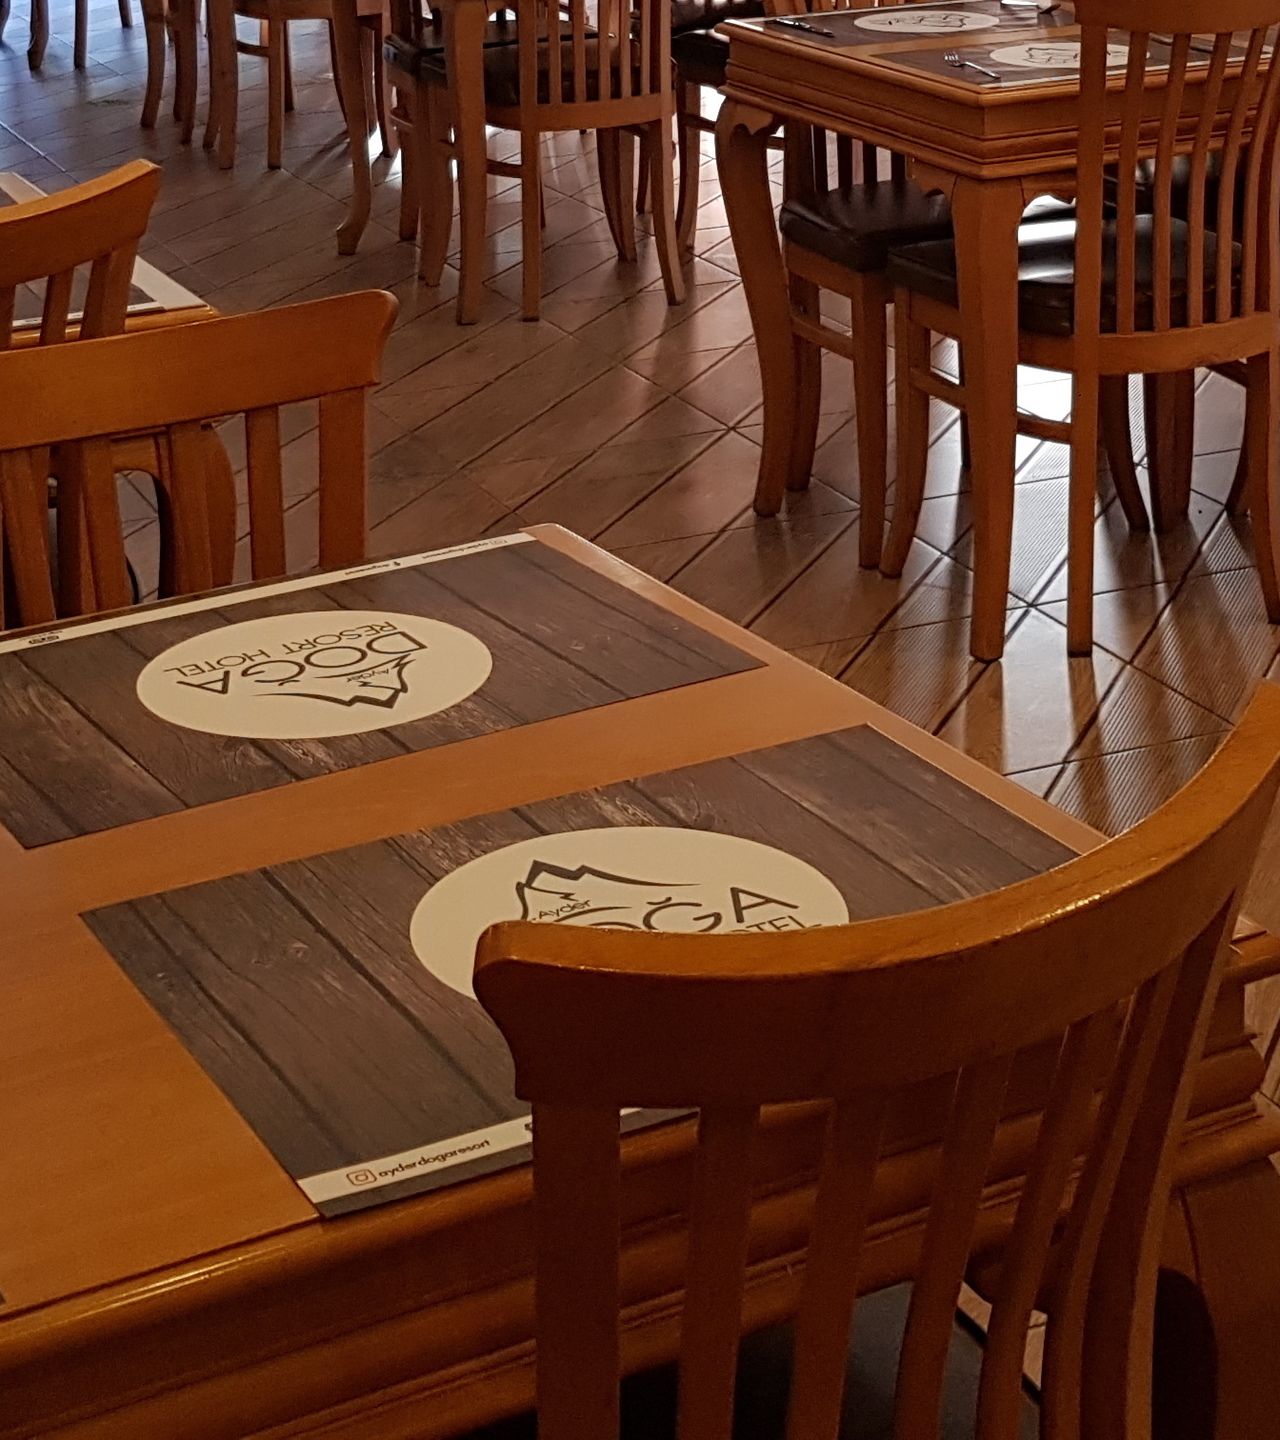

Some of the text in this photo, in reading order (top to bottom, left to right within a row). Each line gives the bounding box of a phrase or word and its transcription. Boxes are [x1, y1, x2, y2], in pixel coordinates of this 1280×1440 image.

[164, 621, 398, 677] RESORT HOTEL
[176, 631, 428, 695] DOĞA
[538, 898, 591, 920] Ayder
